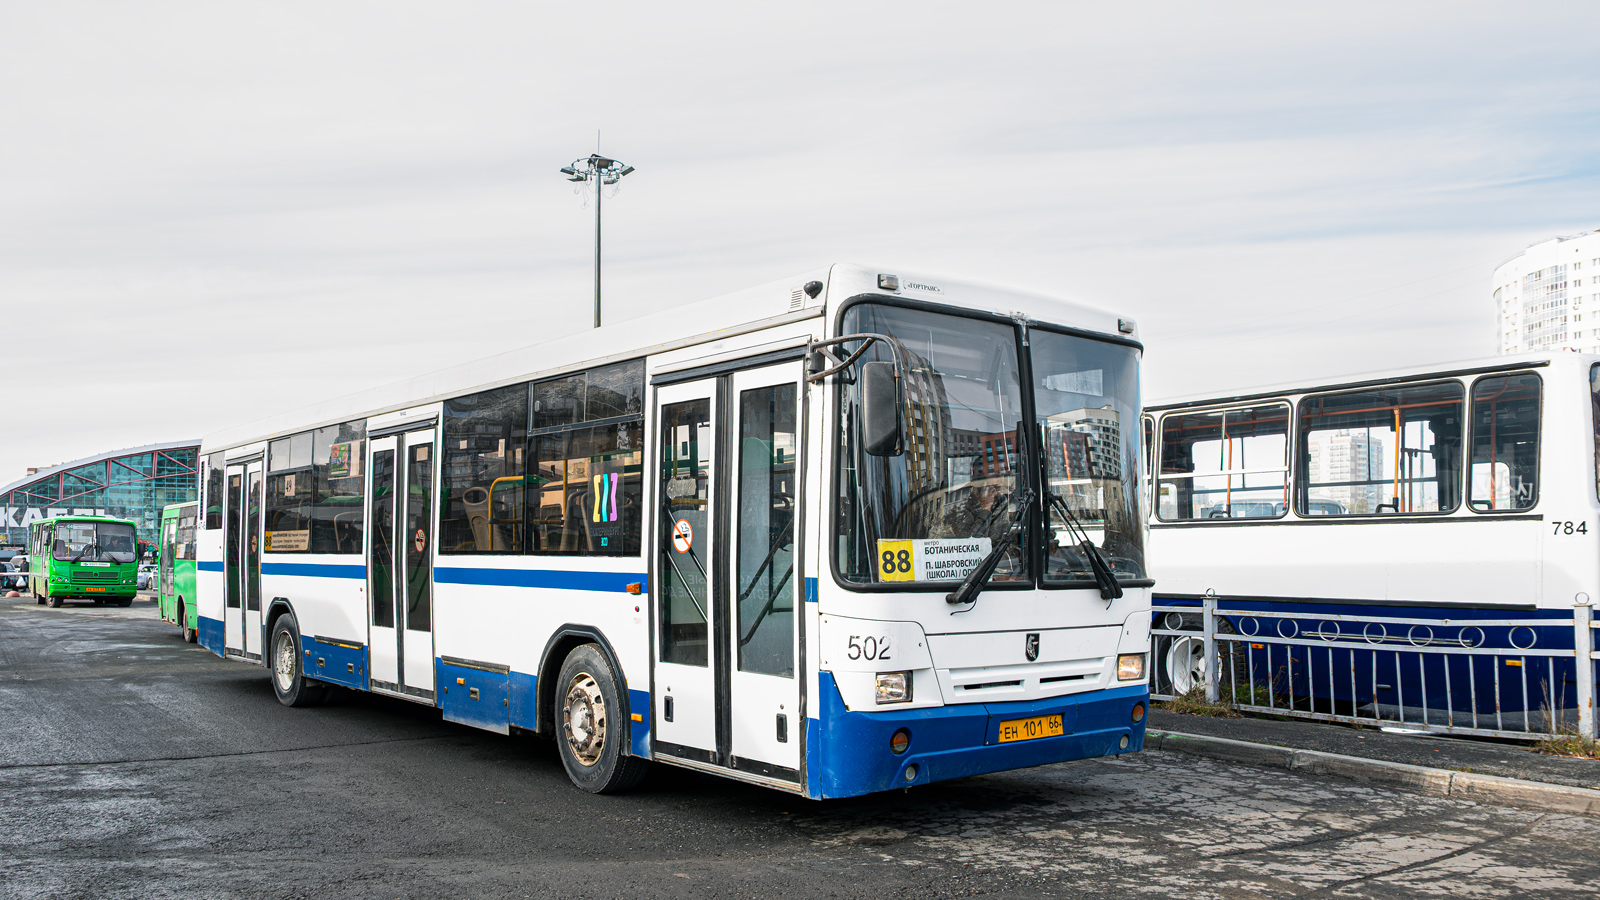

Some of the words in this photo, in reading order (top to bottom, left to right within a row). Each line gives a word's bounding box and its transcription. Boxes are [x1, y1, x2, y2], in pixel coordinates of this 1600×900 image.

[1552, 521, 1588, 536] 784
[924, 544, 980, 555] БОТАНИЧЕСКАЯ
[882, 549, 911, 574] 88
[925, 561, 934, 570] П.
[926, 569, 958, 580] (ШКОЛА)
[847, 635, 891, 661] 502
[1024, 720, 1043, 736] 101
[1048, 716, 1059, 729] 66
